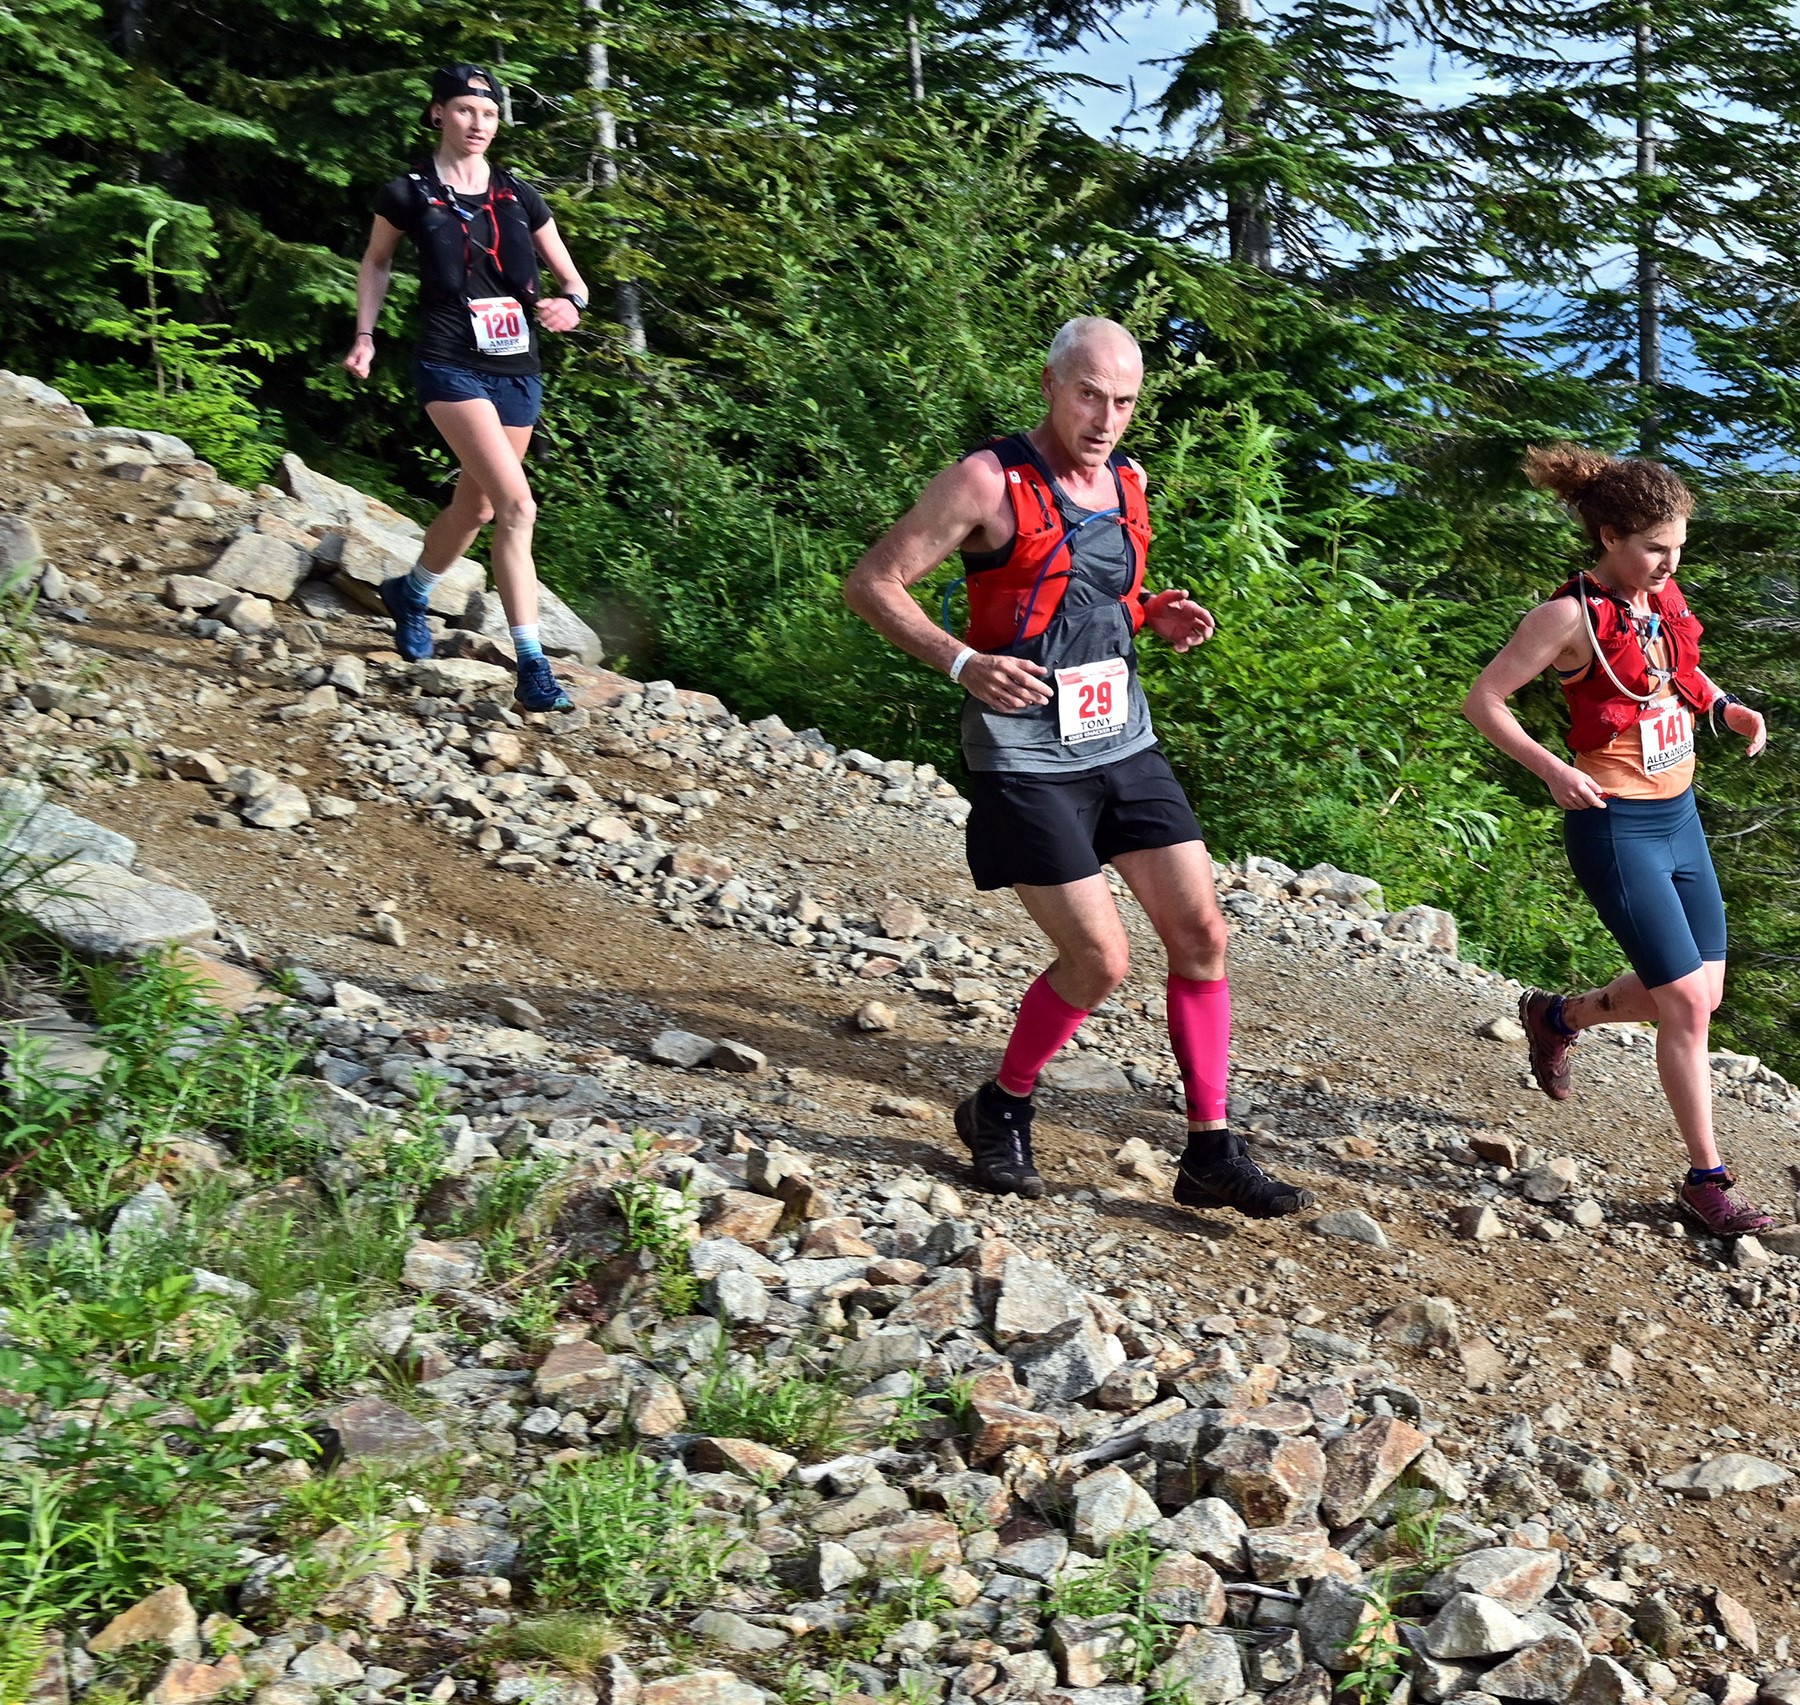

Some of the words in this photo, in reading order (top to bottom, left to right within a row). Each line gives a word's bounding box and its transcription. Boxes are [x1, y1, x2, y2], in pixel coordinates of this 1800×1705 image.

[482, 312, 520, 339] 120
[1079, 681, 1112, 719] 29
[1081, 717, 1112, 730] TONY
[1653, 711, 1685, 751] 141
[1647, 740, 1692, 765] ALEXANDRA
